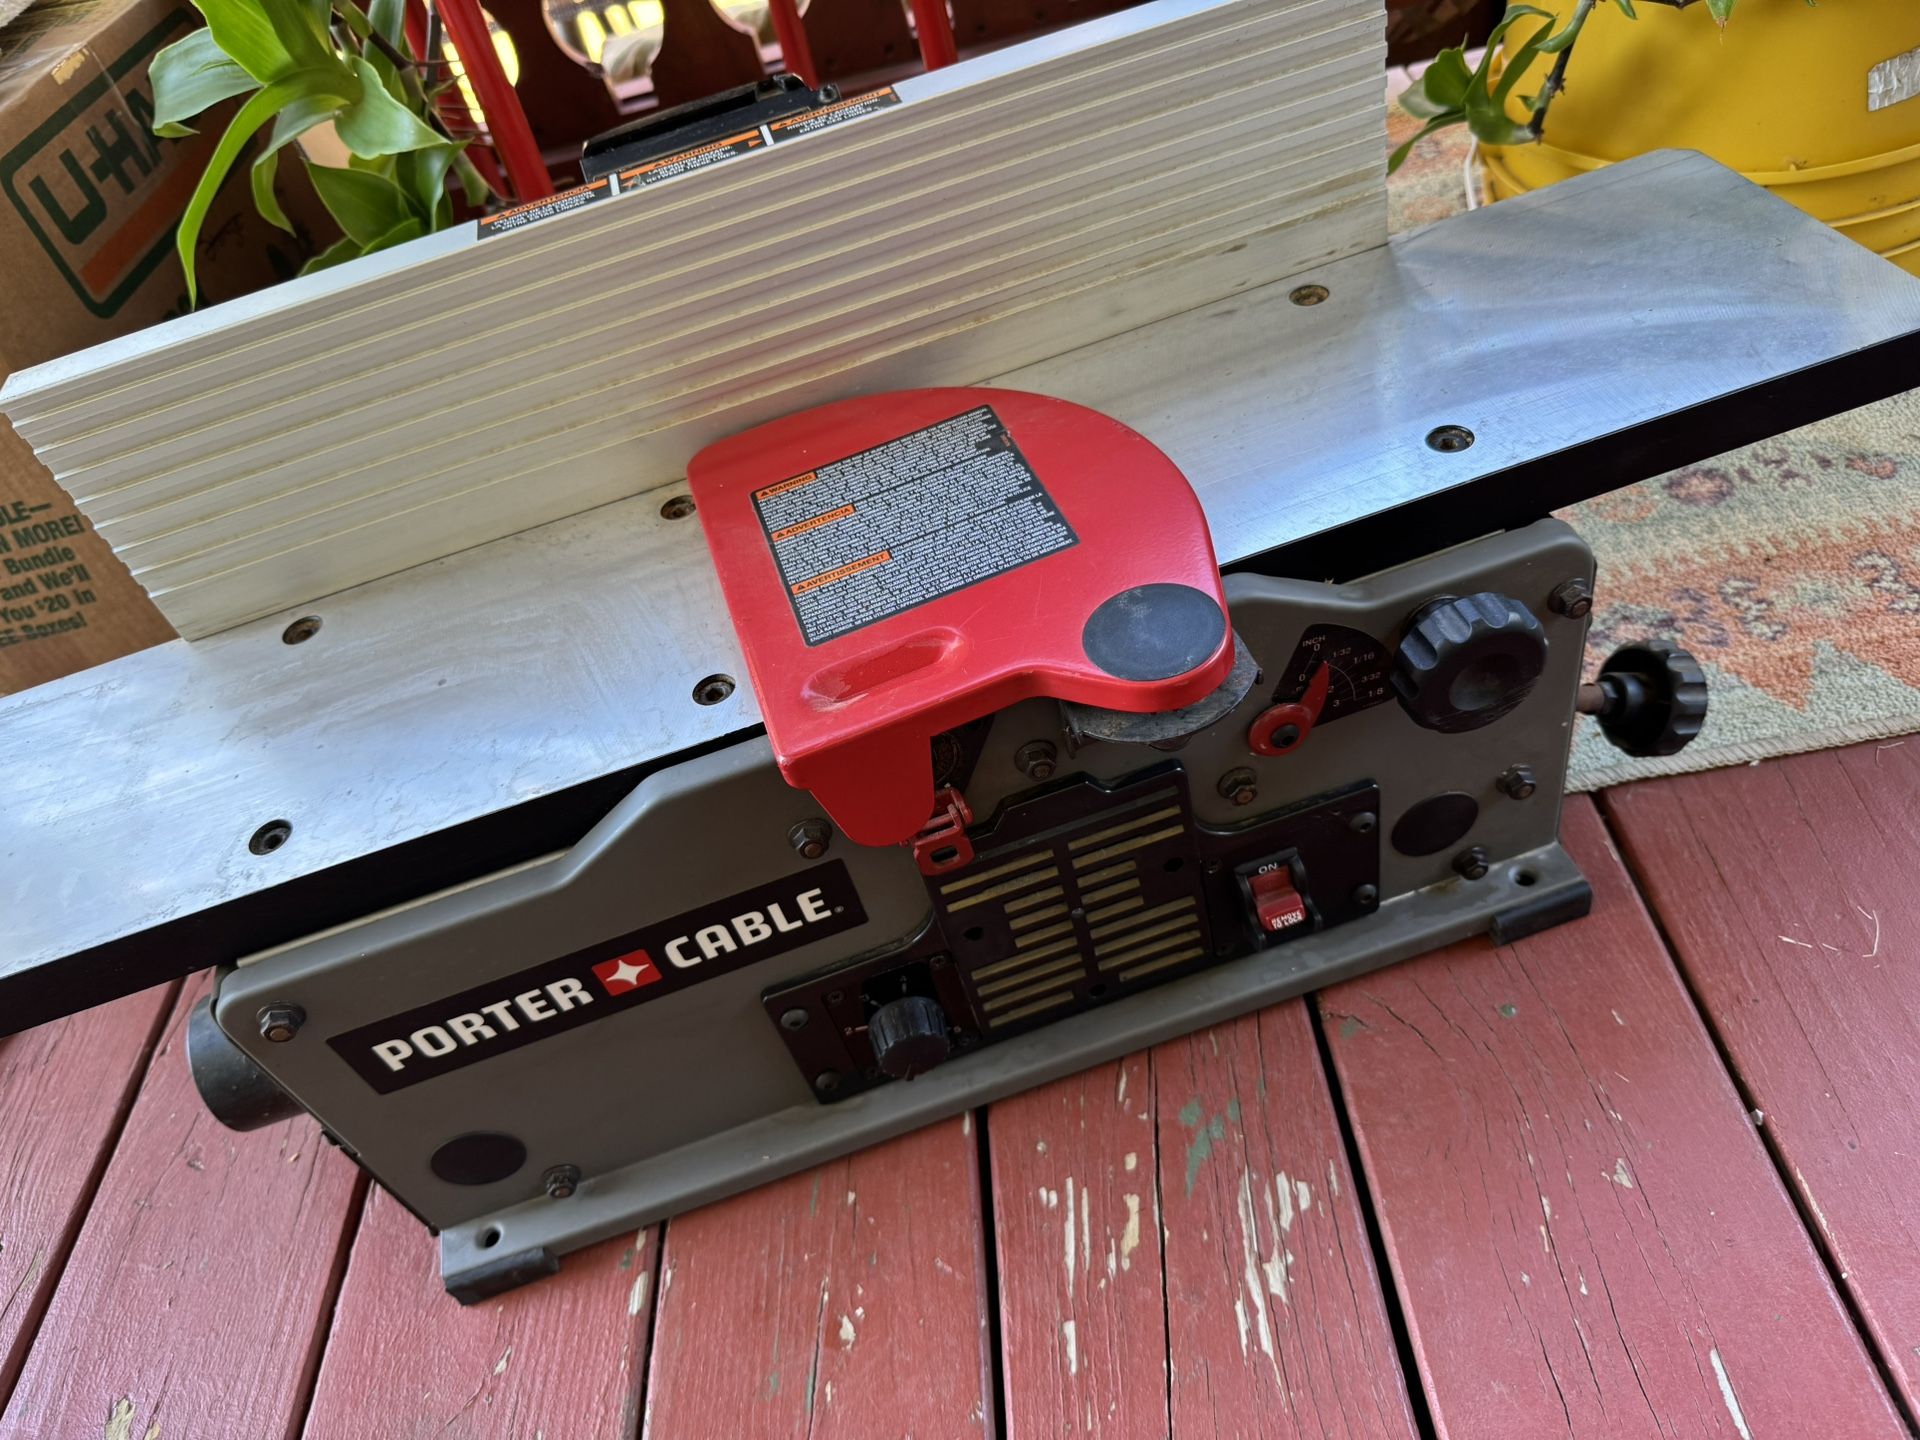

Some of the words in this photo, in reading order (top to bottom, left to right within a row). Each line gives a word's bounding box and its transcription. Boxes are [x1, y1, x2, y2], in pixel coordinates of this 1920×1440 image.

[28, 88, 178, 245] U-HA
[768, 474, 812, 493] WARNING
[12, 514, 85, 549] MORE!
[785, 506, 850, 535] ADVERTENCIA
[3, 546, 76, 575] Bundle
[805, 553, 885, 587] AVERTISSEMENT
[0, 577, 39, 601] and
[37, 564, 92, 590] We'll
[0, 605, 36, 624] You
[21, 611, 88, 641] Boxes!
[1302, 634, 1326, 648] INCH
[1313, 643, 1321, 652] 0
[1299, 673, 1306, 682] 0
[1328, 685, 1335, 694] 2
[1258, 862, 1278, 875] ON
[371, 977, 594, 1072] PORTER
